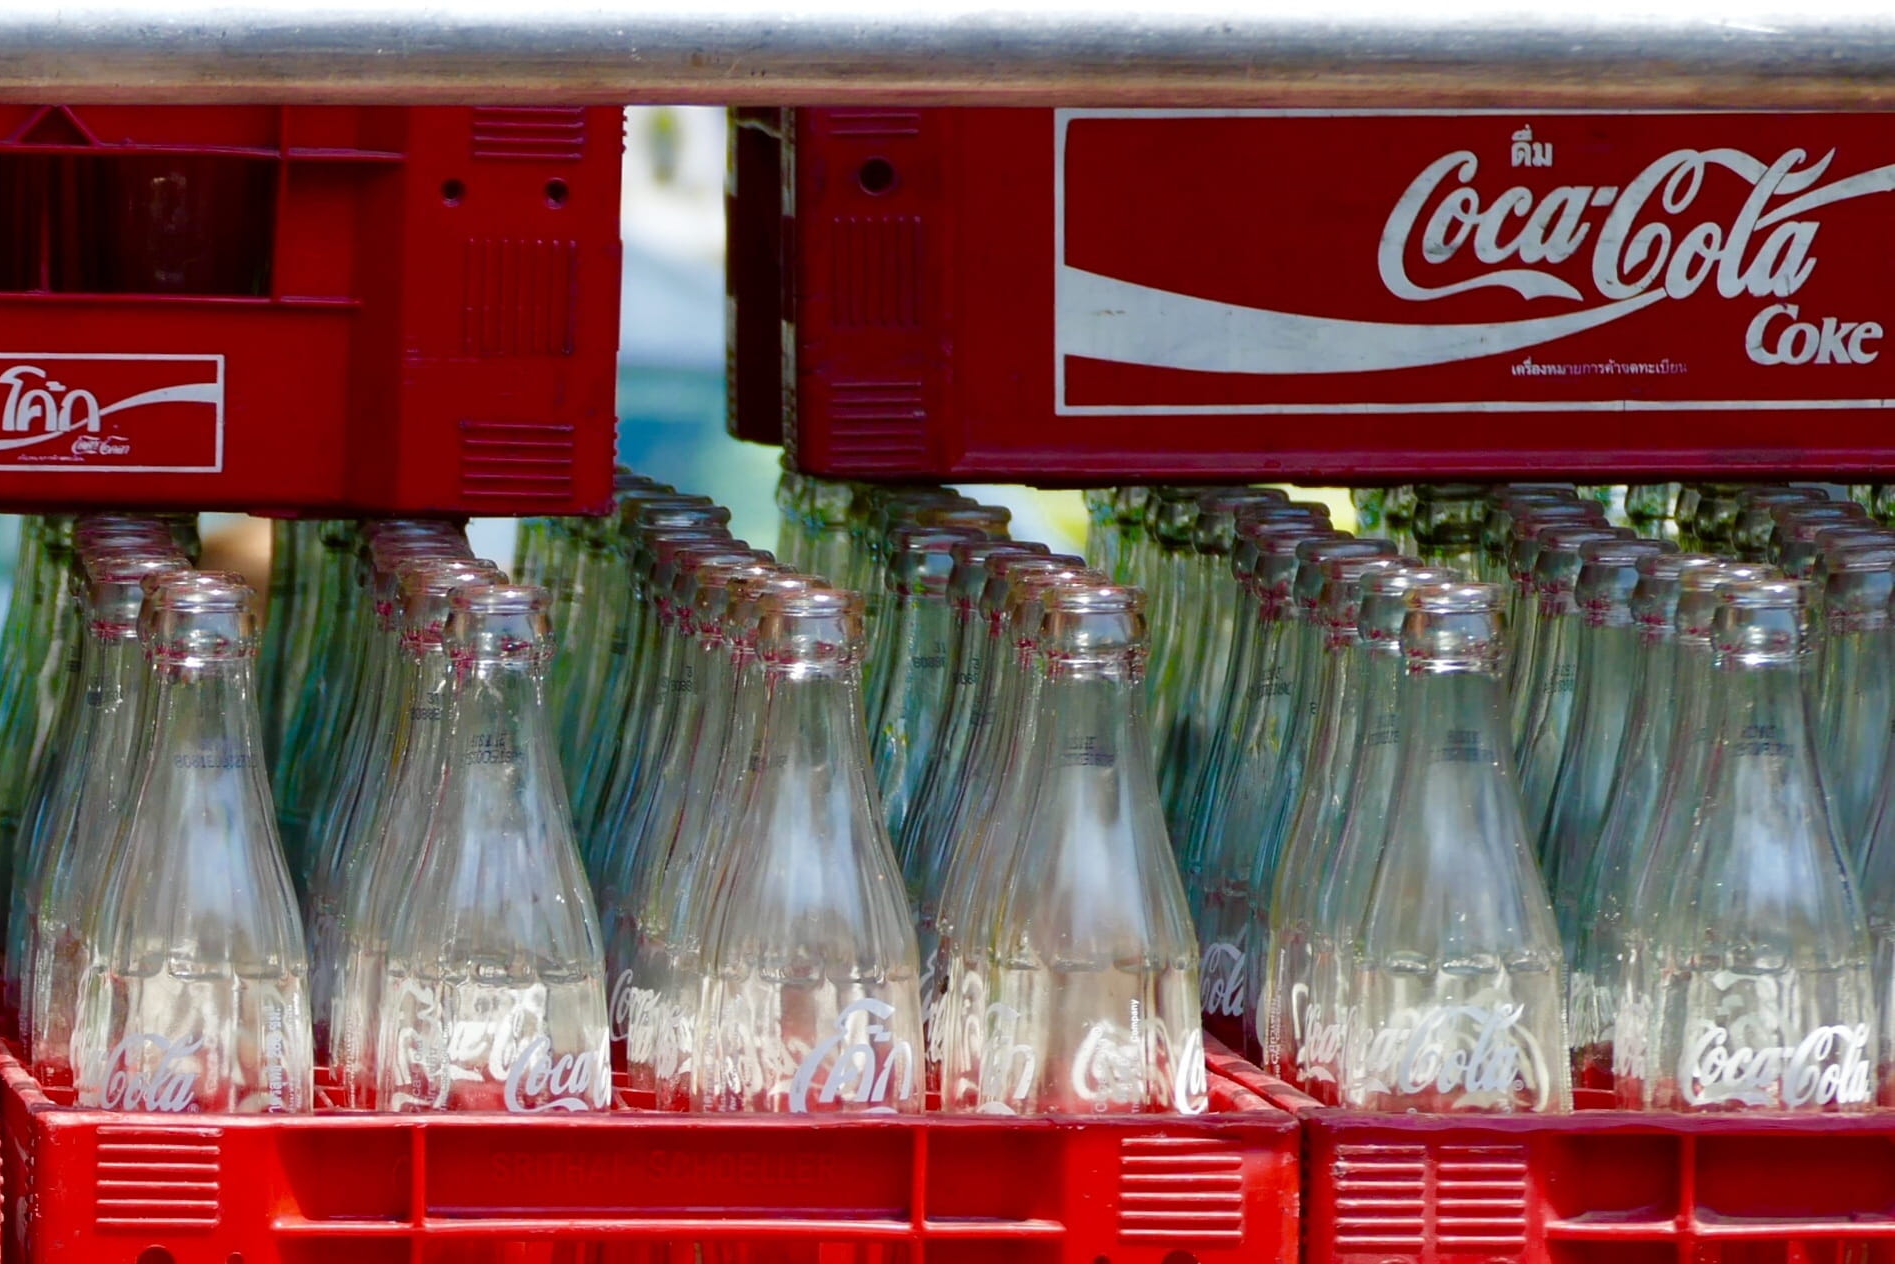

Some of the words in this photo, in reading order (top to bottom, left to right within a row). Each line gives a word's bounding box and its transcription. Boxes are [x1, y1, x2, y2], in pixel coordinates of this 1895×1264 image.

[1511, 125, 1553, 168] ดื่ม
[1377, 147, 1836, 301] Coca-Cola
[1745, 303, 1884, 366] Coke
[1129, 999, 1141, 1042] Company
